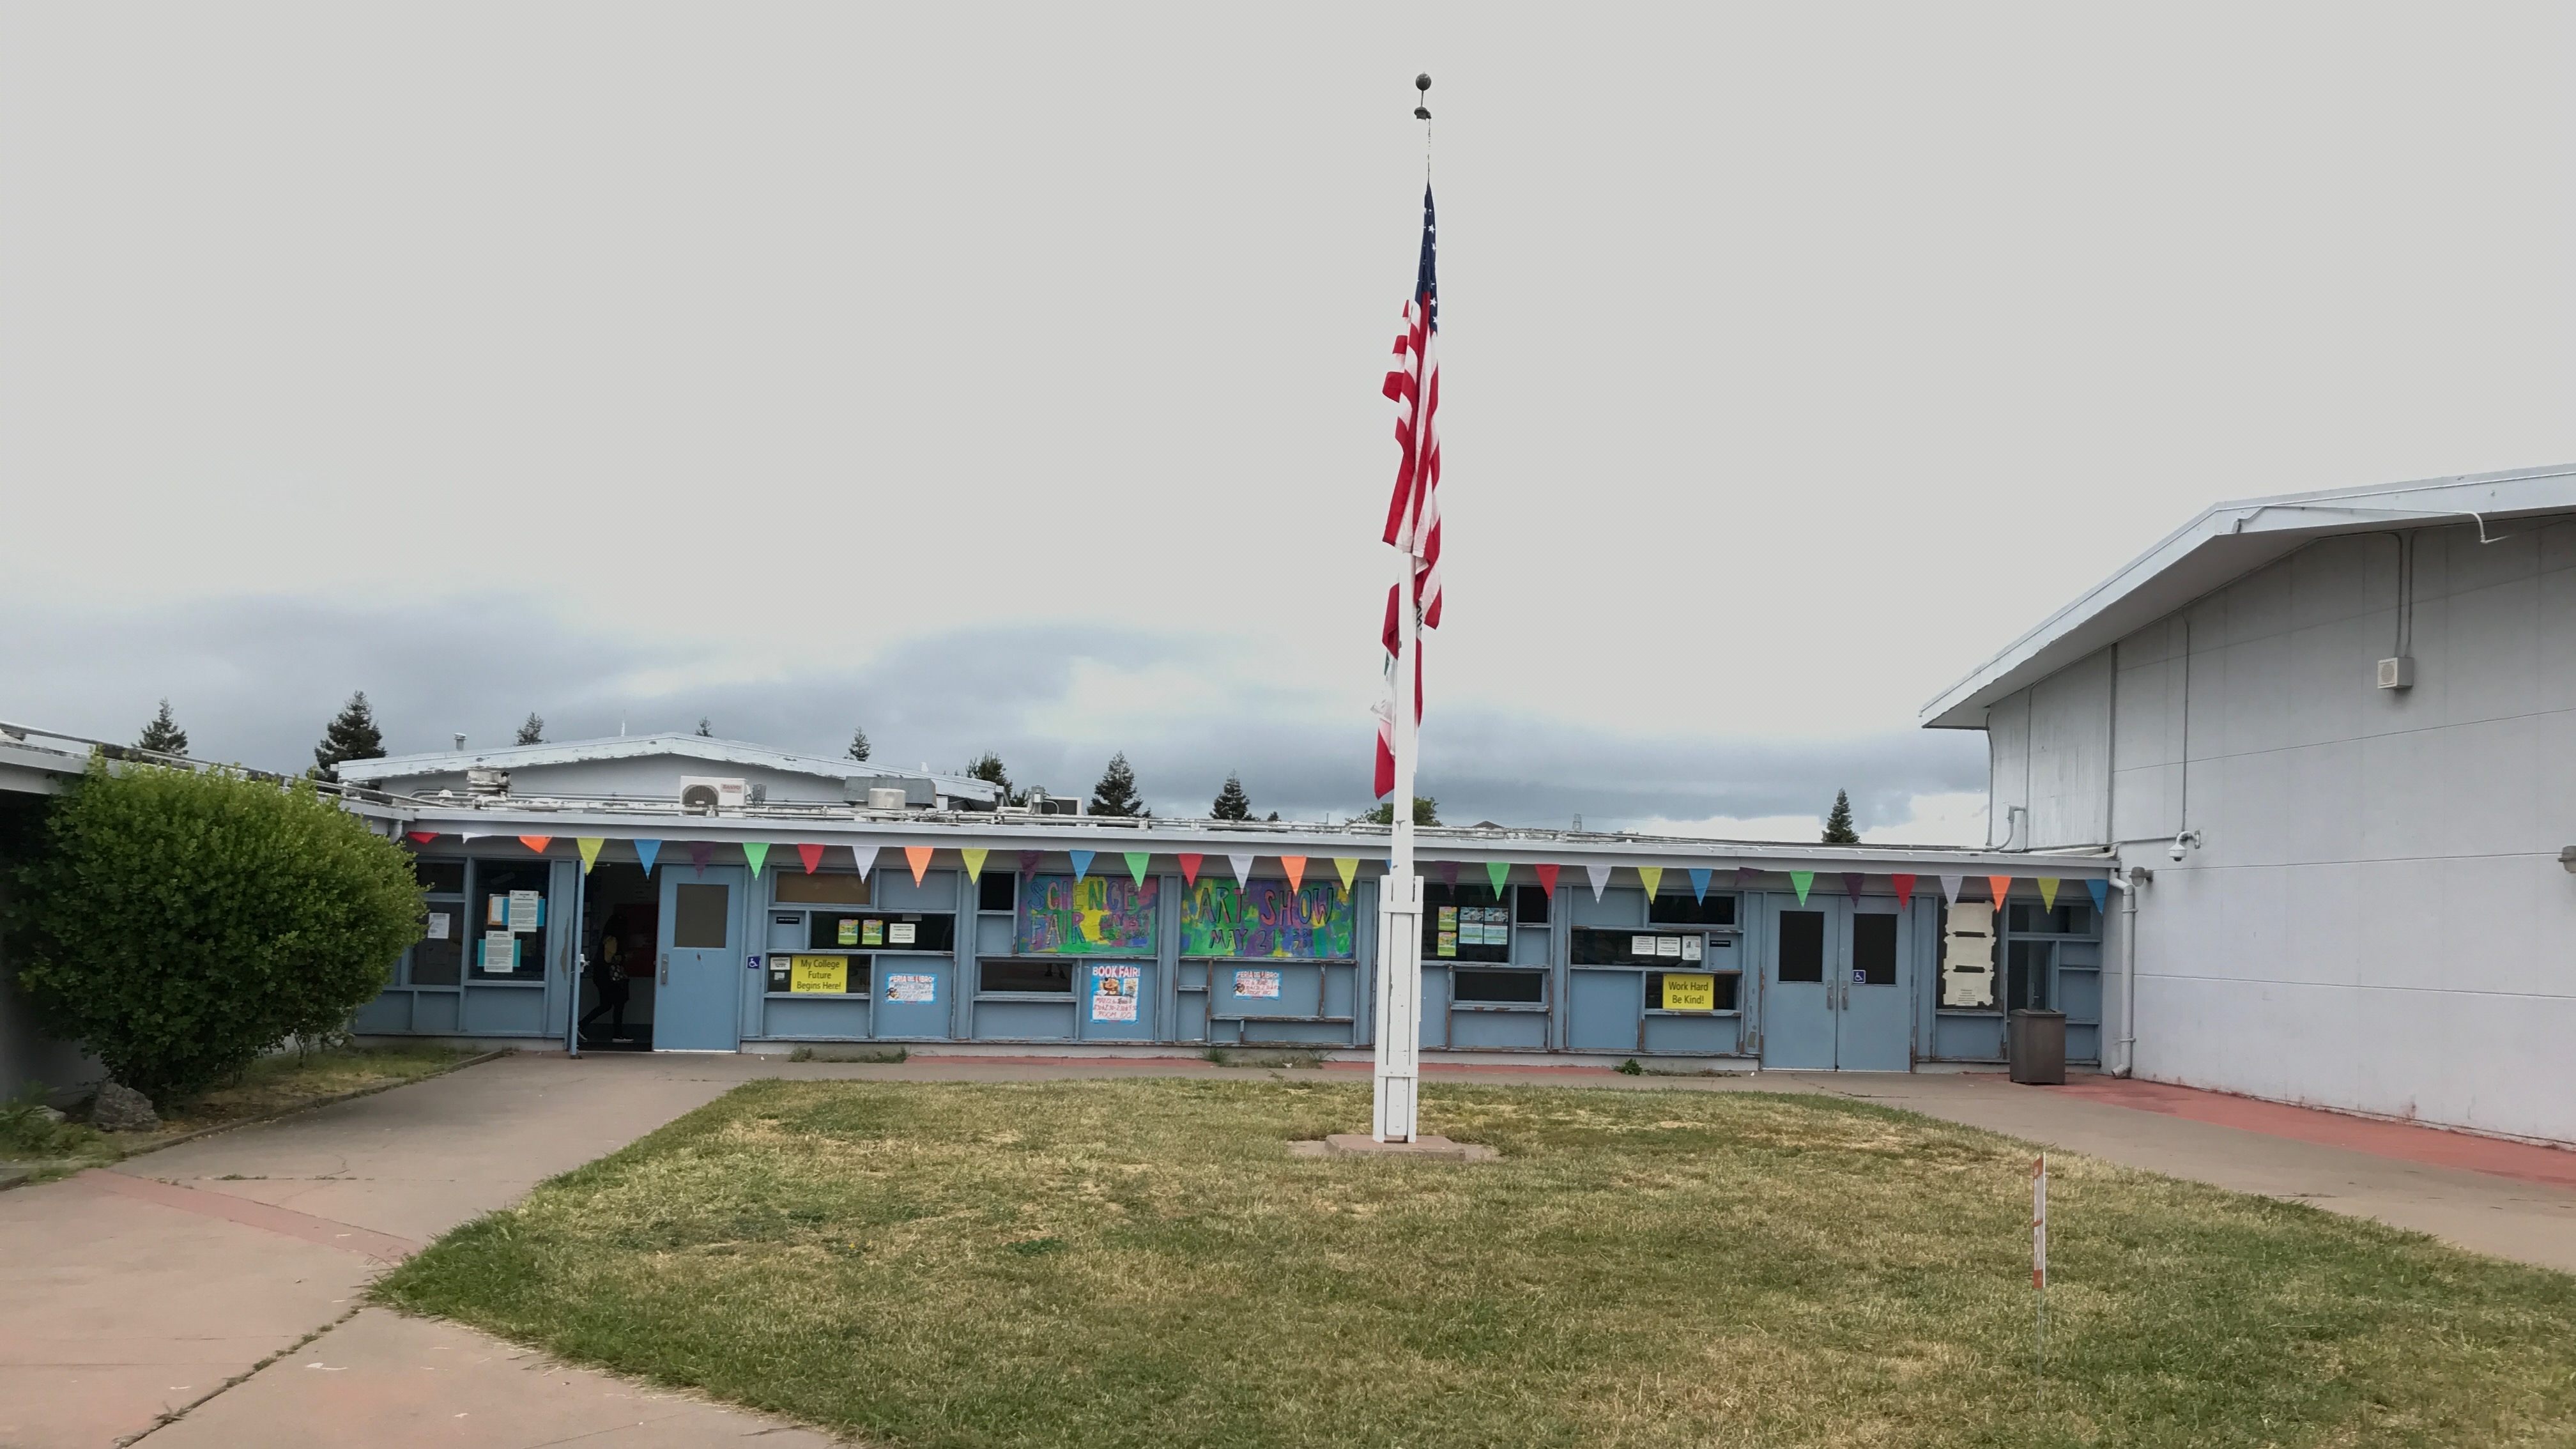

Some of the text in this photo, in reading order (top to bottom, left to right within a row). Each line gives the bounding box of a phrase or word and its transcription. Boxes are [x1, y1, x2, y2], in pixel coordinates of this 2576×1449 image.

[1027, 880, 1137, 910] SCIENCE
[1198, 887, 1334, 926] ART SHOW
[1031, 912, 1086, 945] FAIR
[1209, 929, 1248, 950] MAY
[801, 959, 812, 969] My
[813, 959, 840, 970] College
[808, 970, 831, 979] Future
[1092, 965, 1140, 977] BOOK FAIR!
[797, 981, 841, 991] Begins Here!
[1668, 981, 1708, 991] Work Hard
[1672, 995, 1704, 1004] Be Kind!
